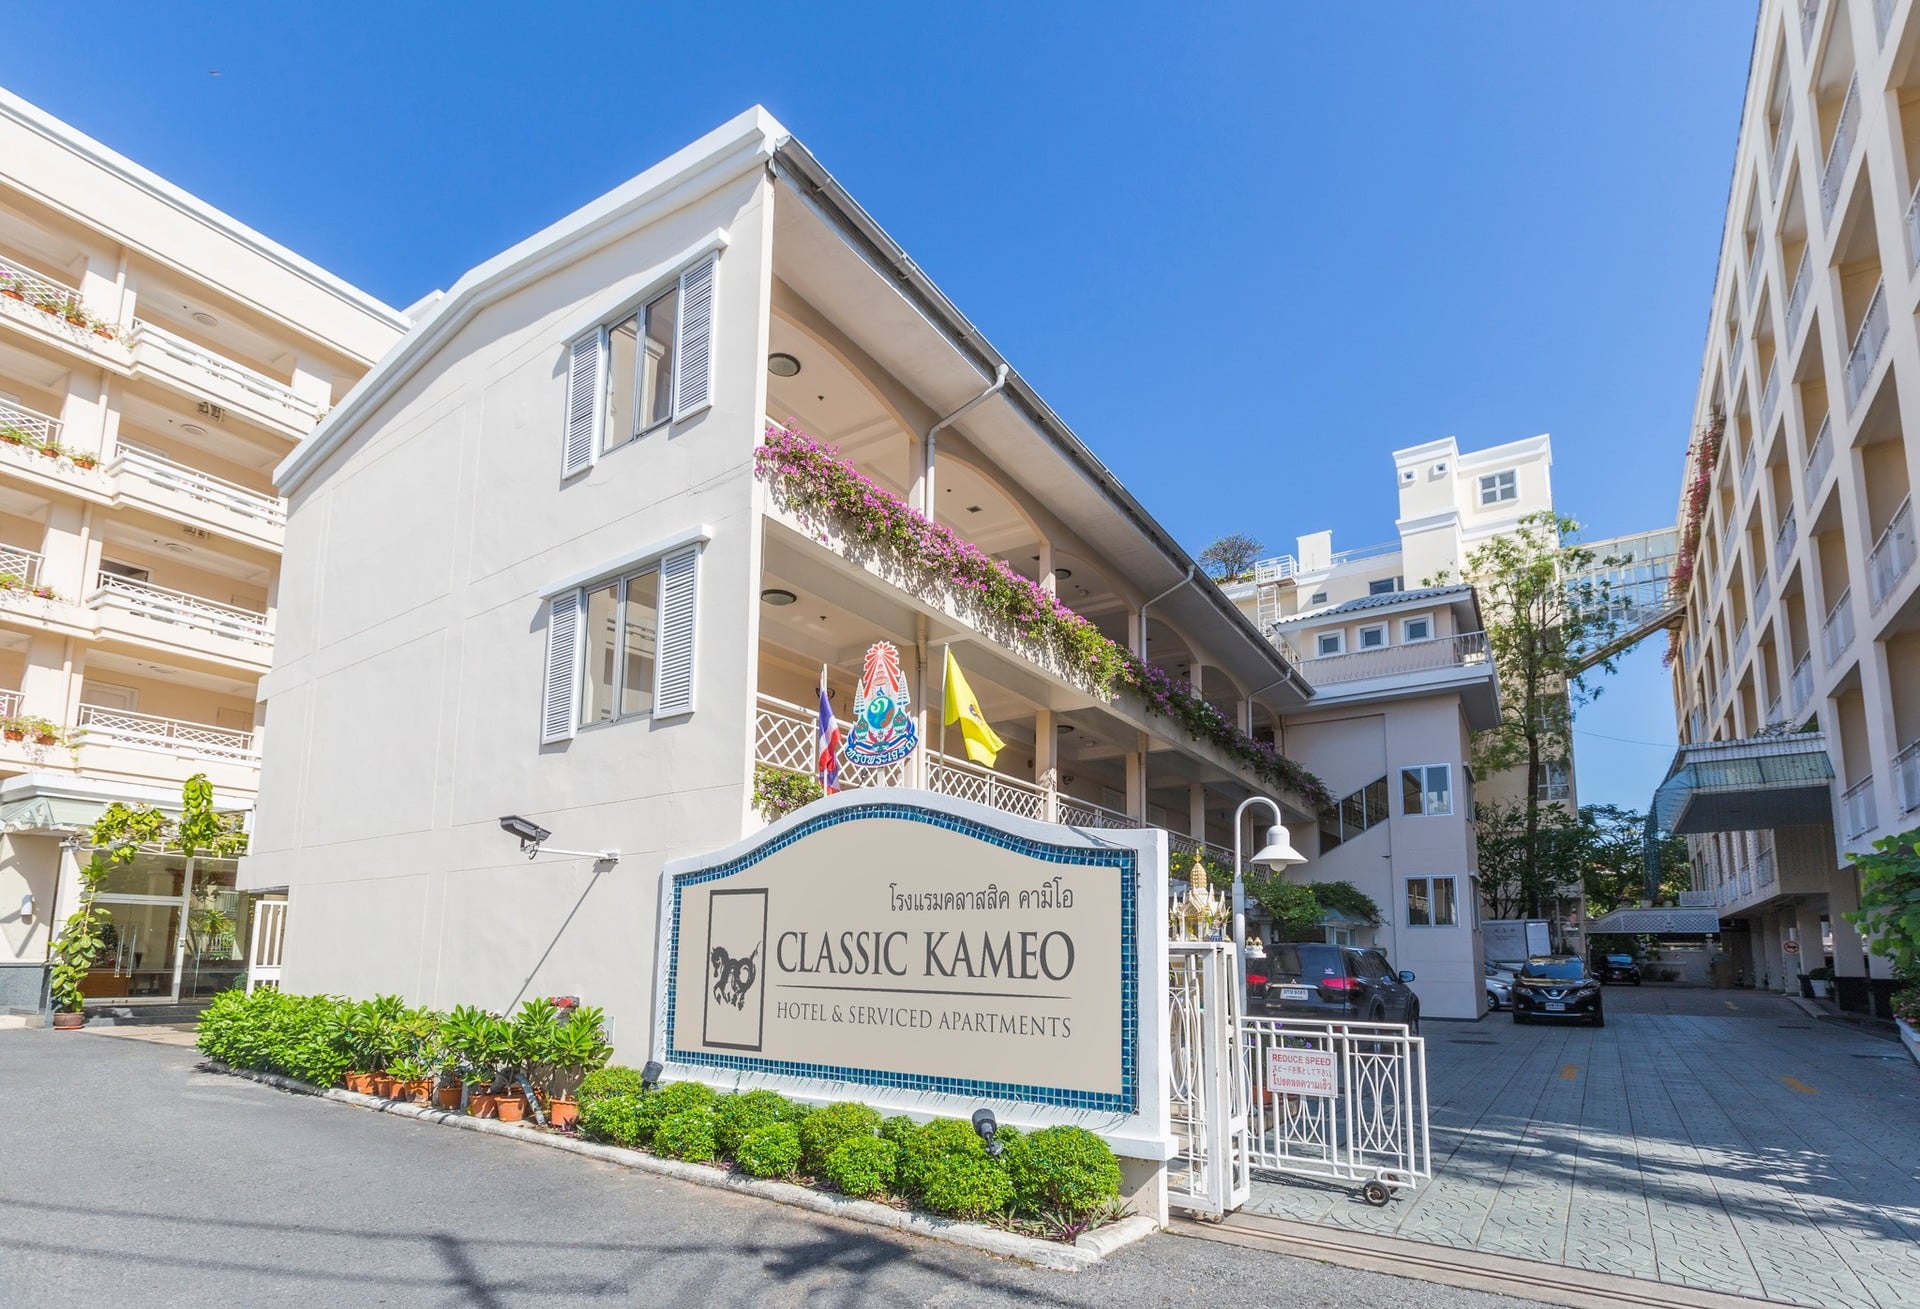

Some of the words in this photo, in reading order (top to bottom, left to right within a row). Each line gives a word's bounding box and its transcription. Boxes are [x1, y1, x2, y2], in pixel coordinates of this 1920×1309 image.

[888, 882, 1010, 912] โรงแรมคลาสสิค
[1018, 876, 1074, 909] คามิโอ
[776, 930, 908, 977] CLASSIC
[923, 930, 1076, 981] KAMEO
[776, 1002, 827, 1023] HOTEL
[831, 1006, 844, 1023] &
[848, 1006, 933, 1030] SERVICED
[937, 1011, 1073, 1039] APARTMENTS
[1272, 1053, 1303, 1064] REDUCE
[1304, 1056, 1331, 1066] SPEED
